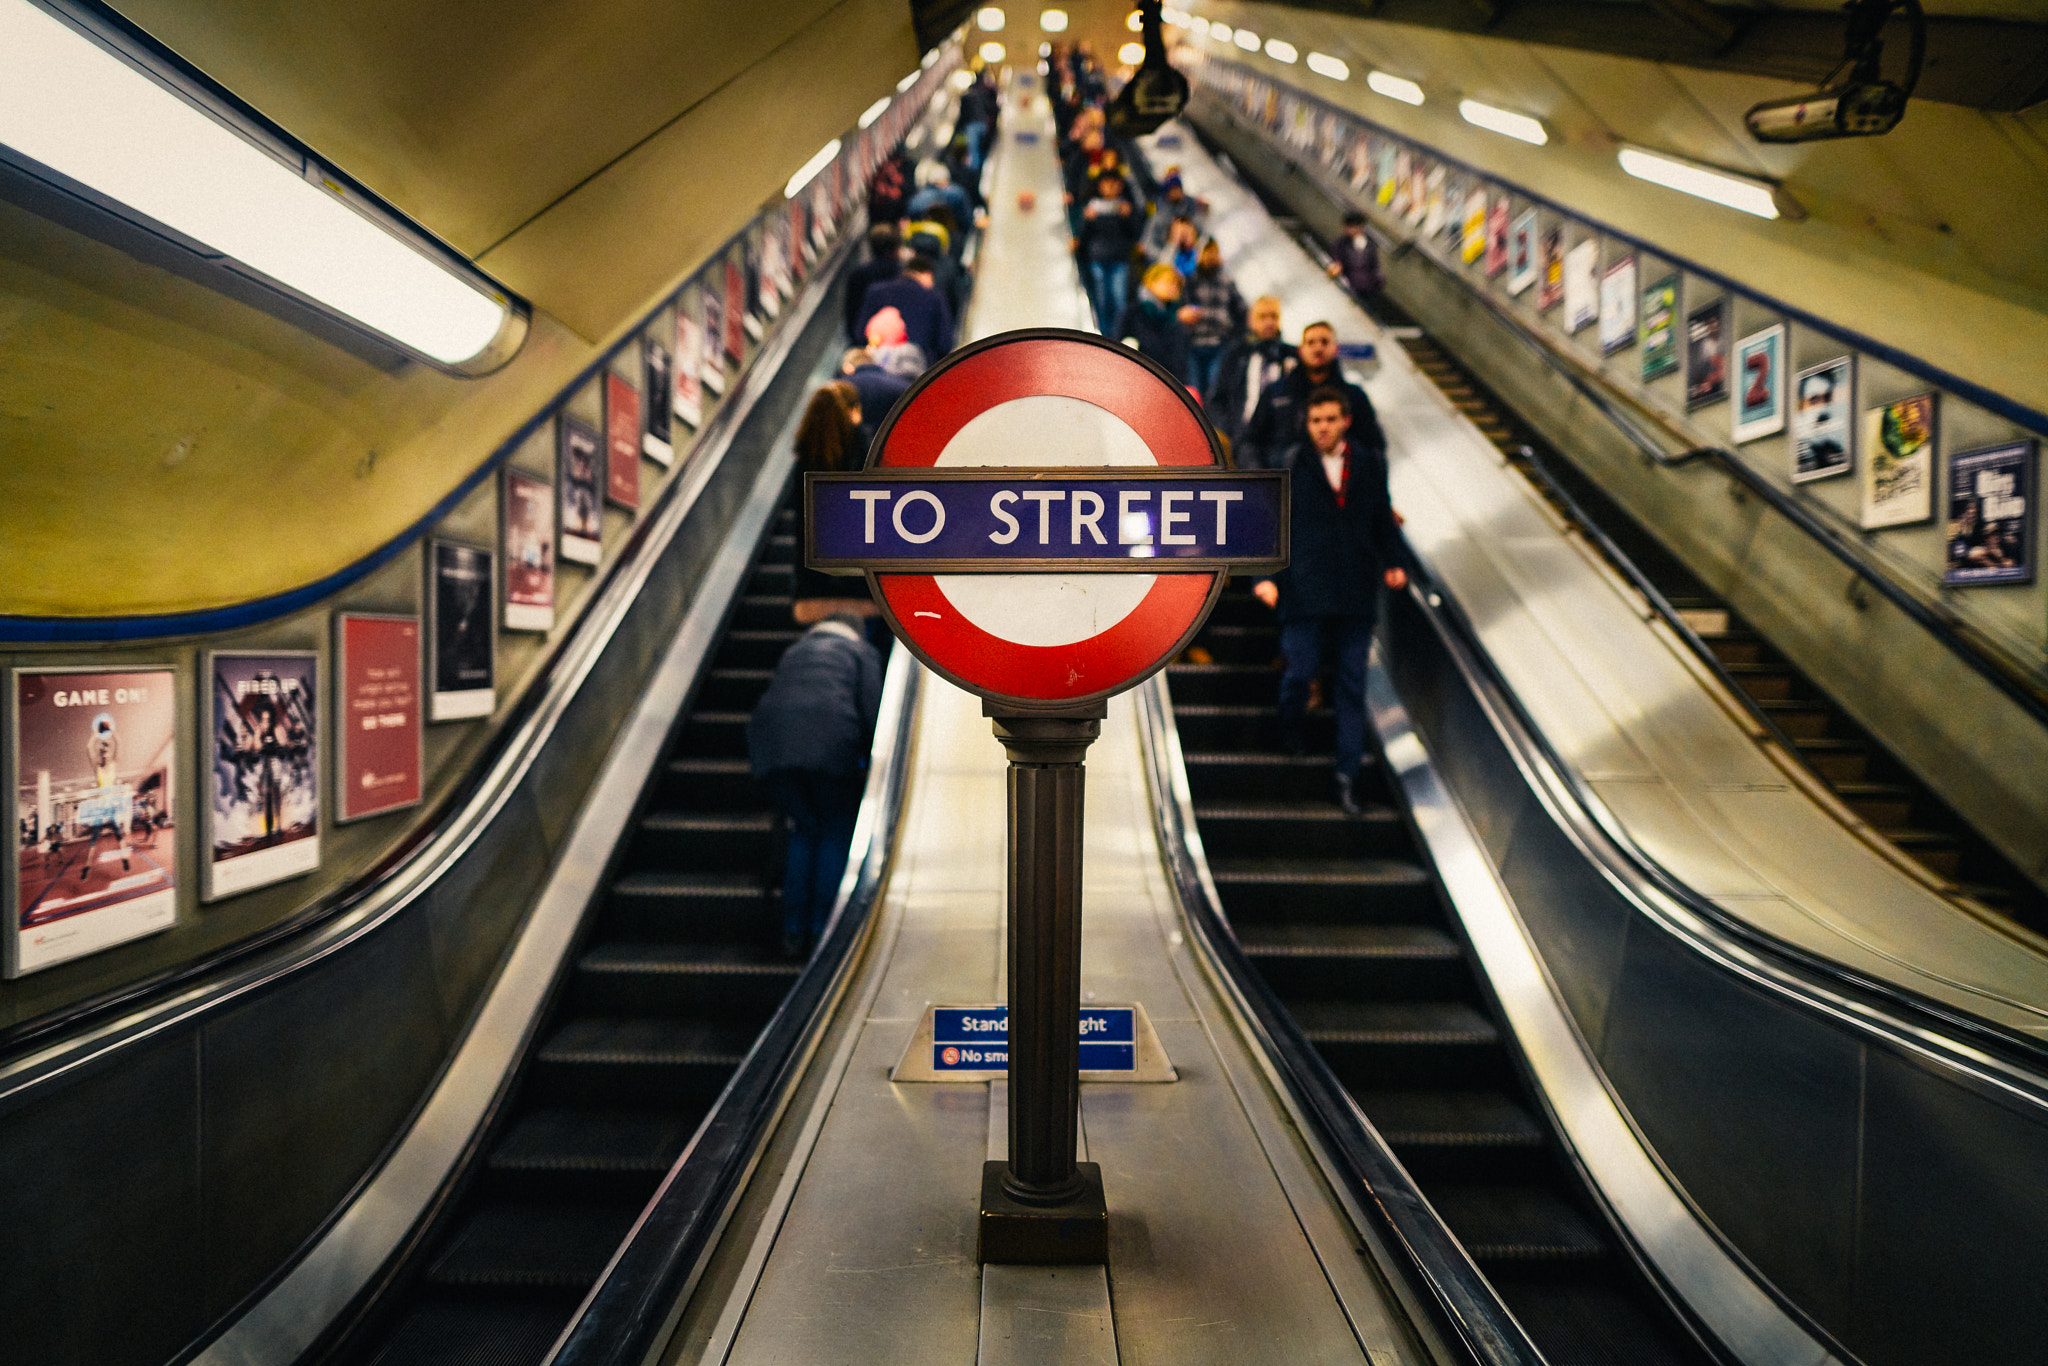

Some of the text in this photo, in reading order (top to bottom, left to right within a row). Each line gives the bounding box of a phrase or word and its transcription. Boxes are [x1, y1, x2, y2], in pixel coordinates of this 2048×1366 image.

[850, 490, 1243, 545] TO STREET
[53, 689, 110, 707] GAME
[962, 1017, 1107, 1034] Stand ght
[961, 1050, 982, 1062] No
